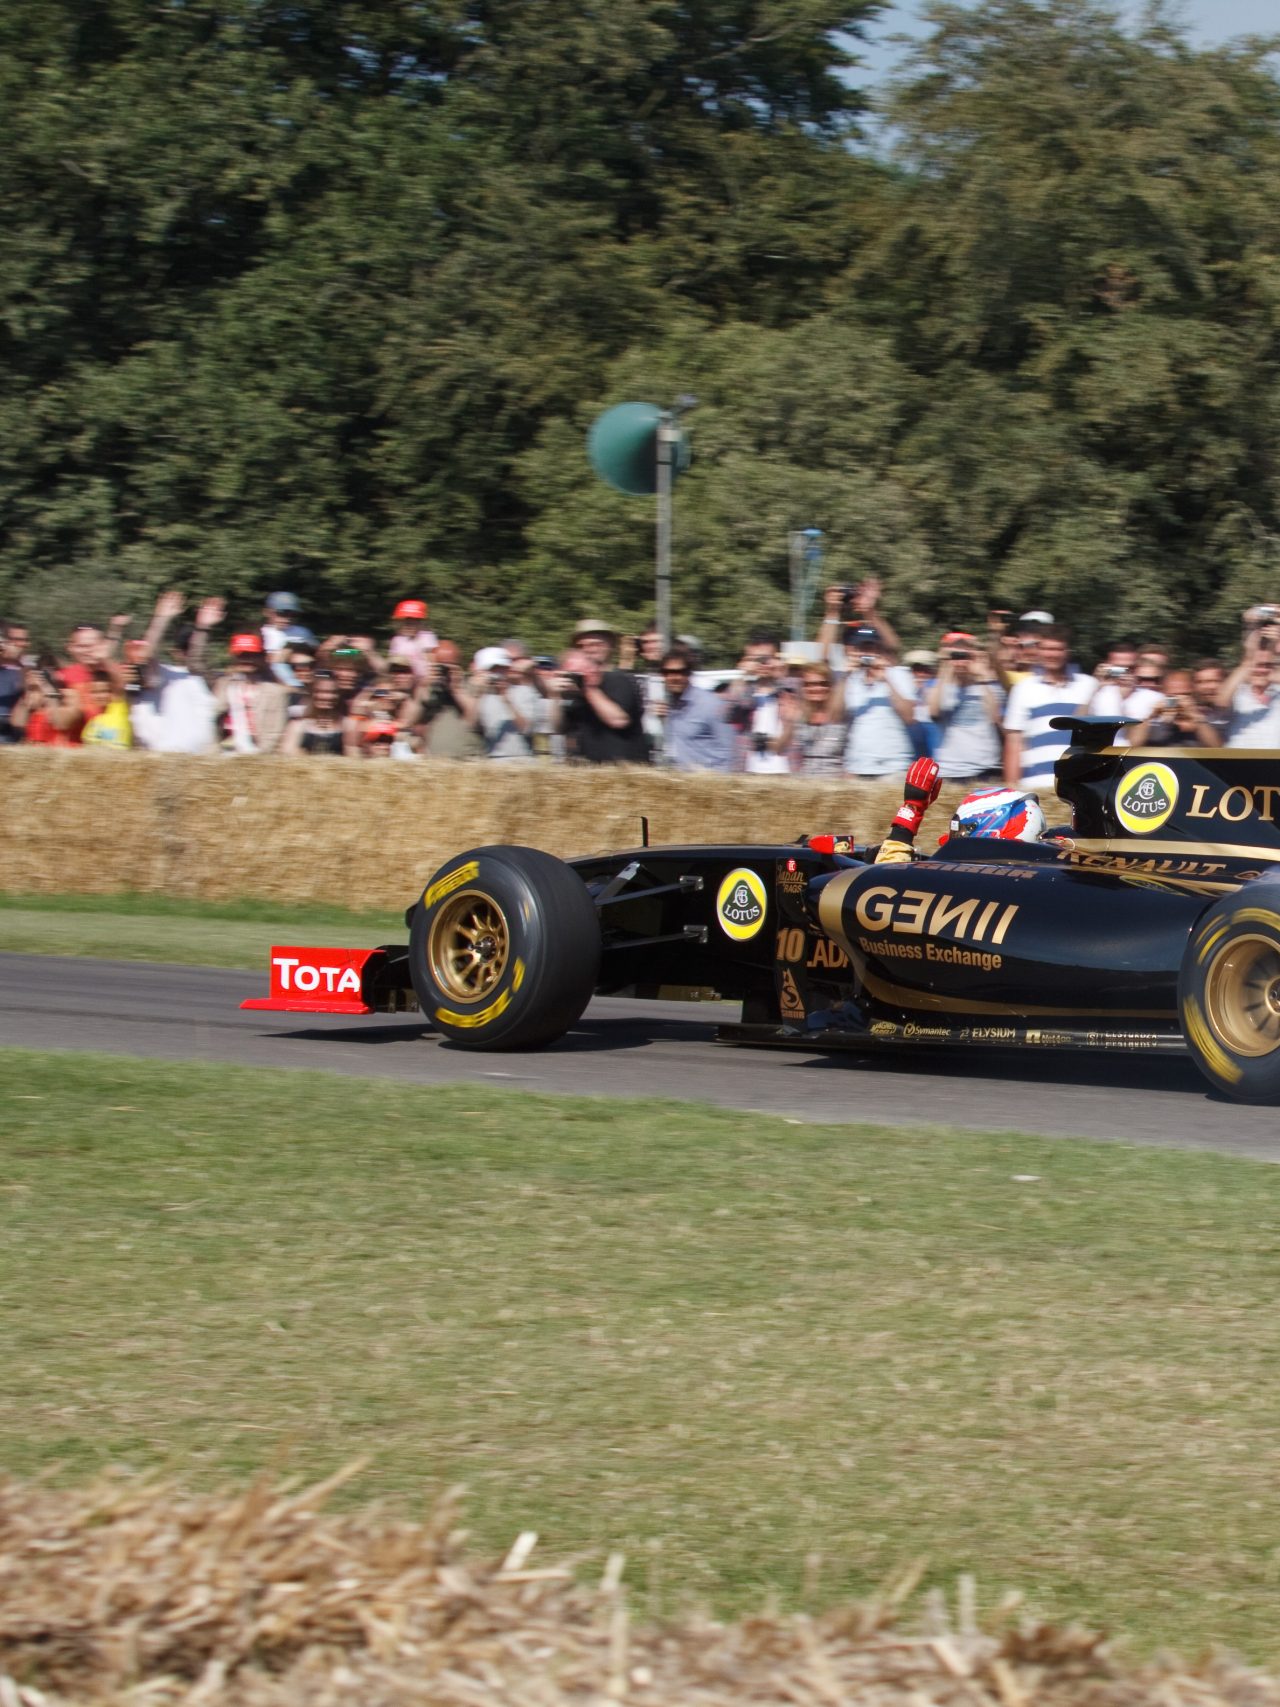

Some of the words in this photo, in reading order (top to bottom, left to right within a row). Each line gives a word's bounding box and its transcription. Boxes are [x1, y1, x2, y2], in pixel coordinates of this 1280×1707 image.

[1123, 795, 1167, 814] LOTUS
[1056, 850, 1227, 876] RENAULT
[724, 904, 760, 920] LOTUS
[776, 927, 805, 963] 10
[860, 937, 923, 959] Business
[926, 943, 1002, 971] Exchange
[272, 957, 361, 992] TOTA
[972, 1027, 1016, 1038] ELYSIUM
